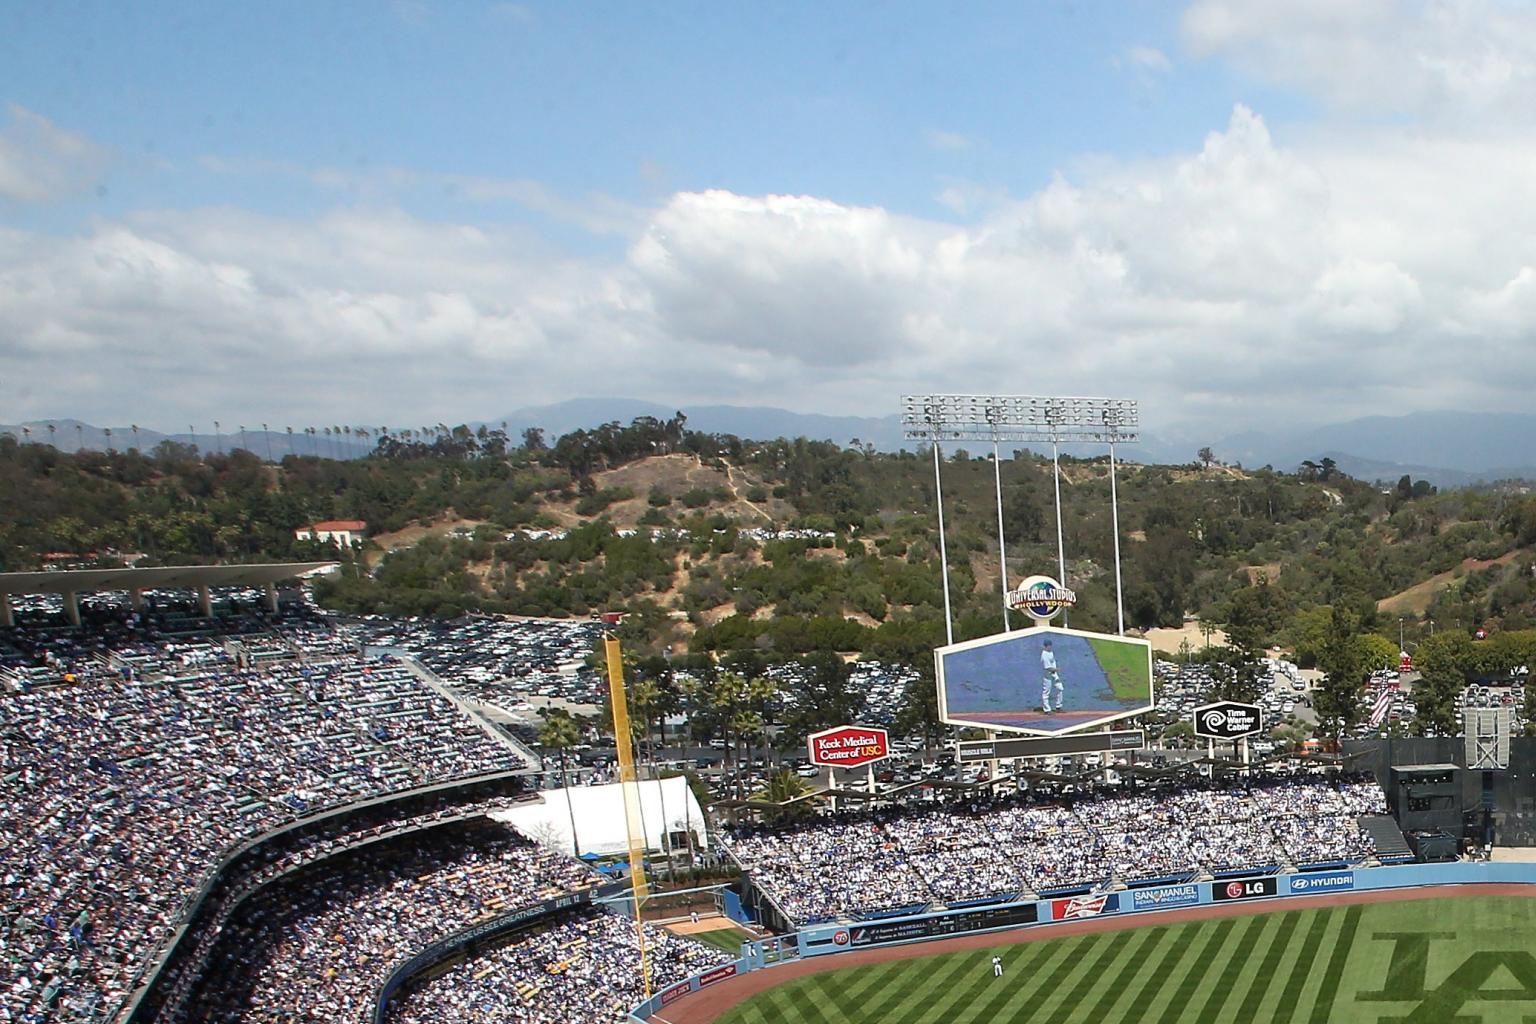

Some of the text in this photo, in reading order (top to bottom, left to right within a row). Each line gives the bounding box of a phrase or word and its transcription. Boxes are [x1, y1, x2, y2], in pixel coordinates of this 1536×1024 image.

[1010, 587, 1077, 604] UNIVERSAL STUDIOS
[1020, 600, 1068, 608] HOLLYWOOD
[1226, 724, 1250, 732] Cable
[818, 735, 878, 750] Keck Medical
[820, 746, 882, 760] Center of USC
[1310, 876, 1352, 887] HYUNDAI
[1134, 886, 1197, 900] SAN MANUEL
[1246, 882, 1264, 894] LG
[555, 896, 572, 908] APRIL
